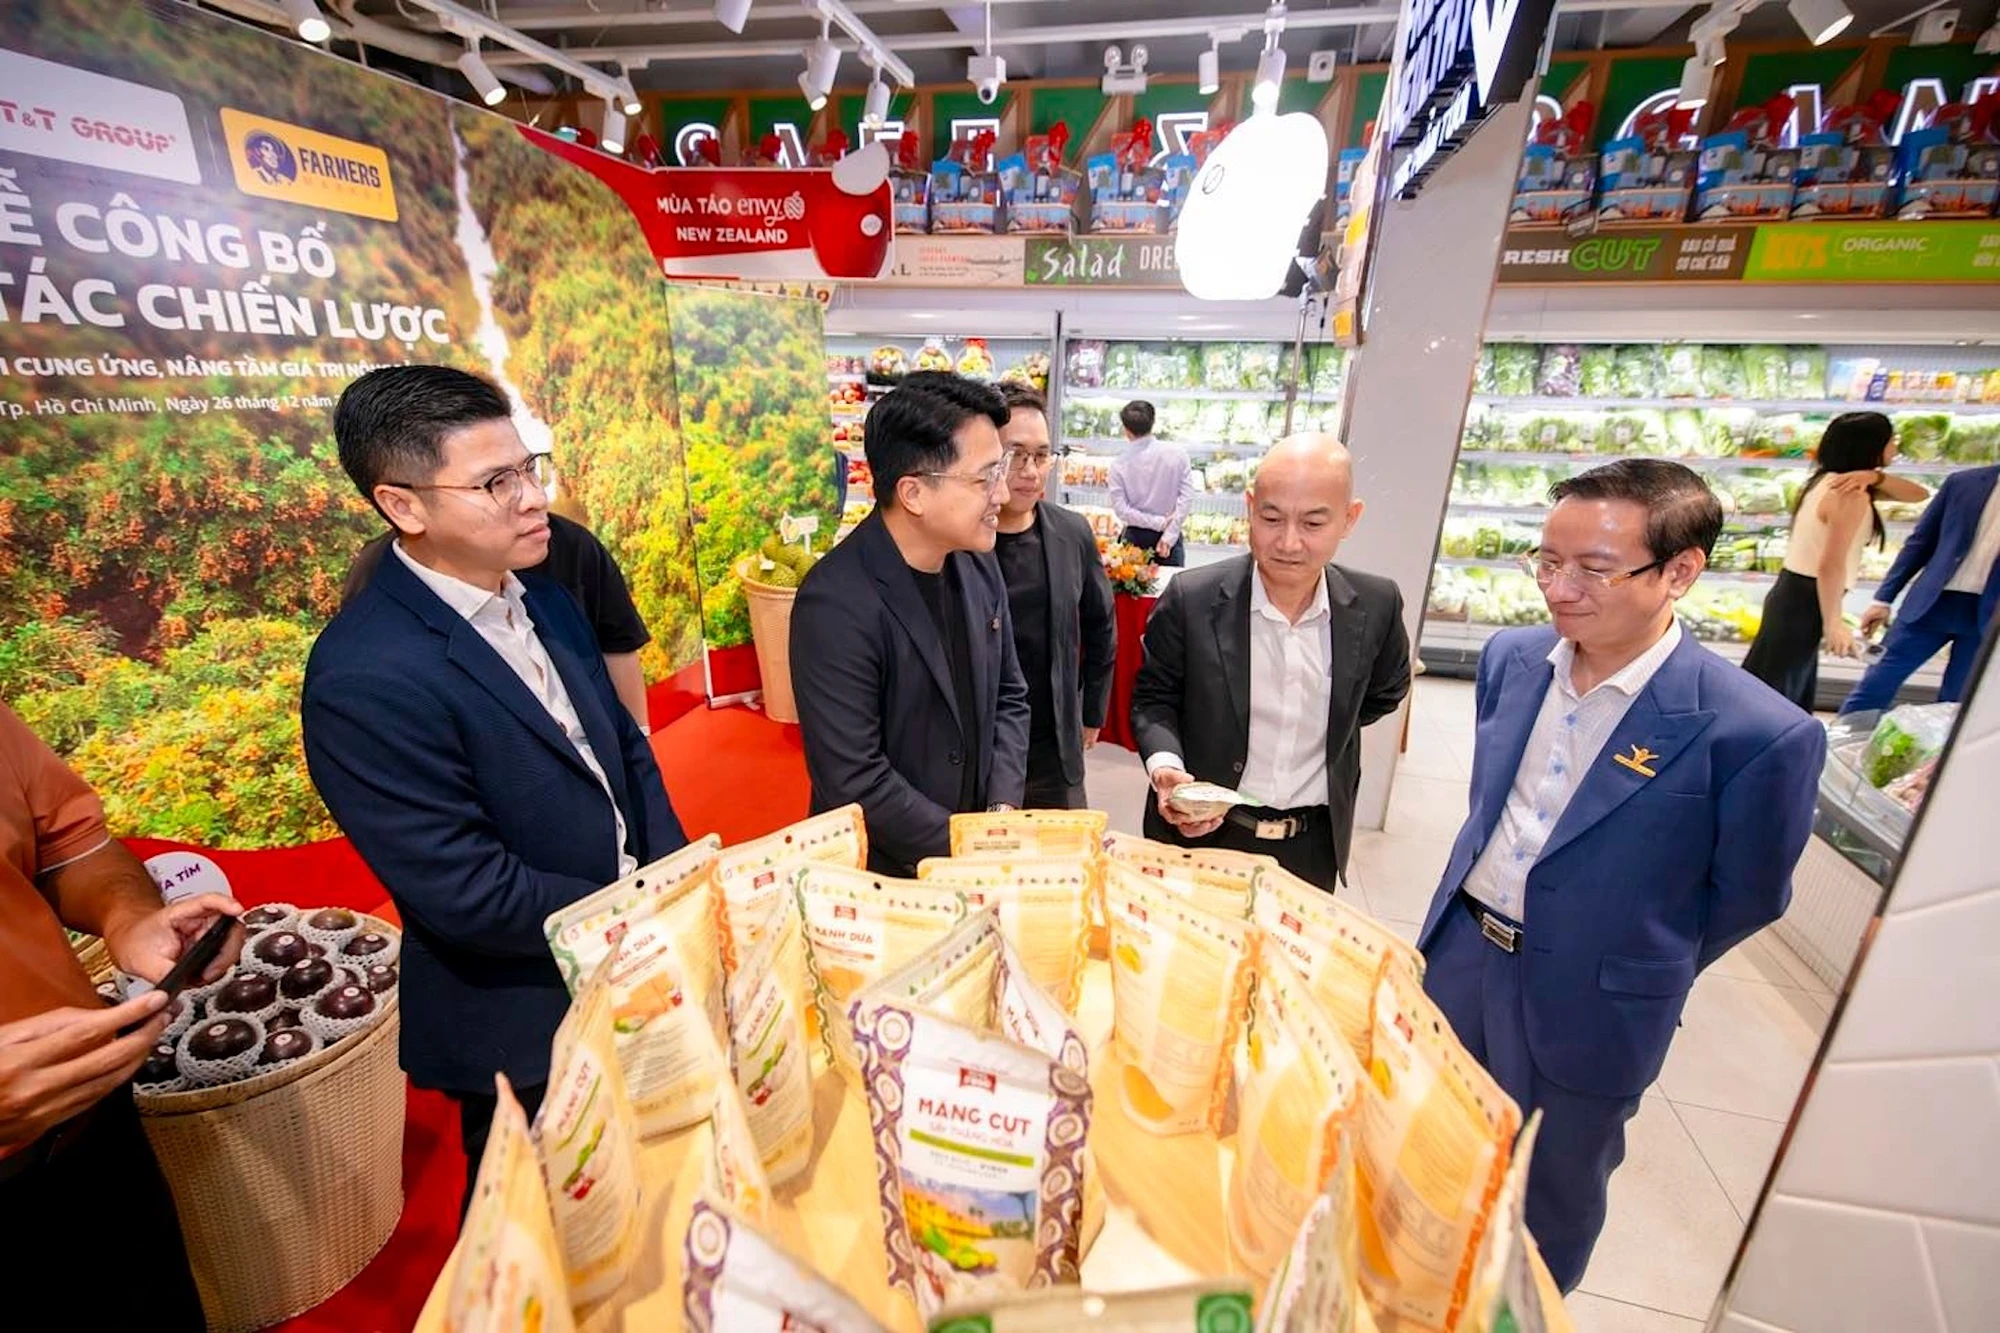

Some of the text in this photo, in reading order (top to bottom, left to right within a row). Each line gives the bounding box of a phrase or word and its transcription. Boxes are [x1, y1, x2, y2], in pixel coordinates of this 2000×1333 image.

[71, 116, 170, 153] GROUP
[298, 147, 382, 188] FARMERS
[656, 193, 694, 215] MÙA
[697, 192, 732, 215] TÁO
[0, 167, 337, 279] Ễ CÔNG BỐ
[676, 226, 788, 244] NEW ZEALAND
[1042, 244, 1178, 280] Salad DRE
[1502, 249, 1571, 265] RESH
[1571, 236, 1661, 272] CUT
[1843, 237, 1931, 252] ORGANIC
[137, 276, 317, 337] CHIẾN
[324, 300, 450, 351] LƯỢC
[14, 357, 94, 376] CUNG
[98, 353, 164, 378] ỨNG,
[167, 355, 233, 376] NÂNG
[35, 397, 66, 415] Hồ
[71, 397, 104, 414] Chí
[109, 398, 162, 413] Minh,
[167, 396, 208, 414] Ngày
[213, 396, 233, 410] 26
[235, 395, 282, 411] tháng
[283, 396, 300, 408] 12
